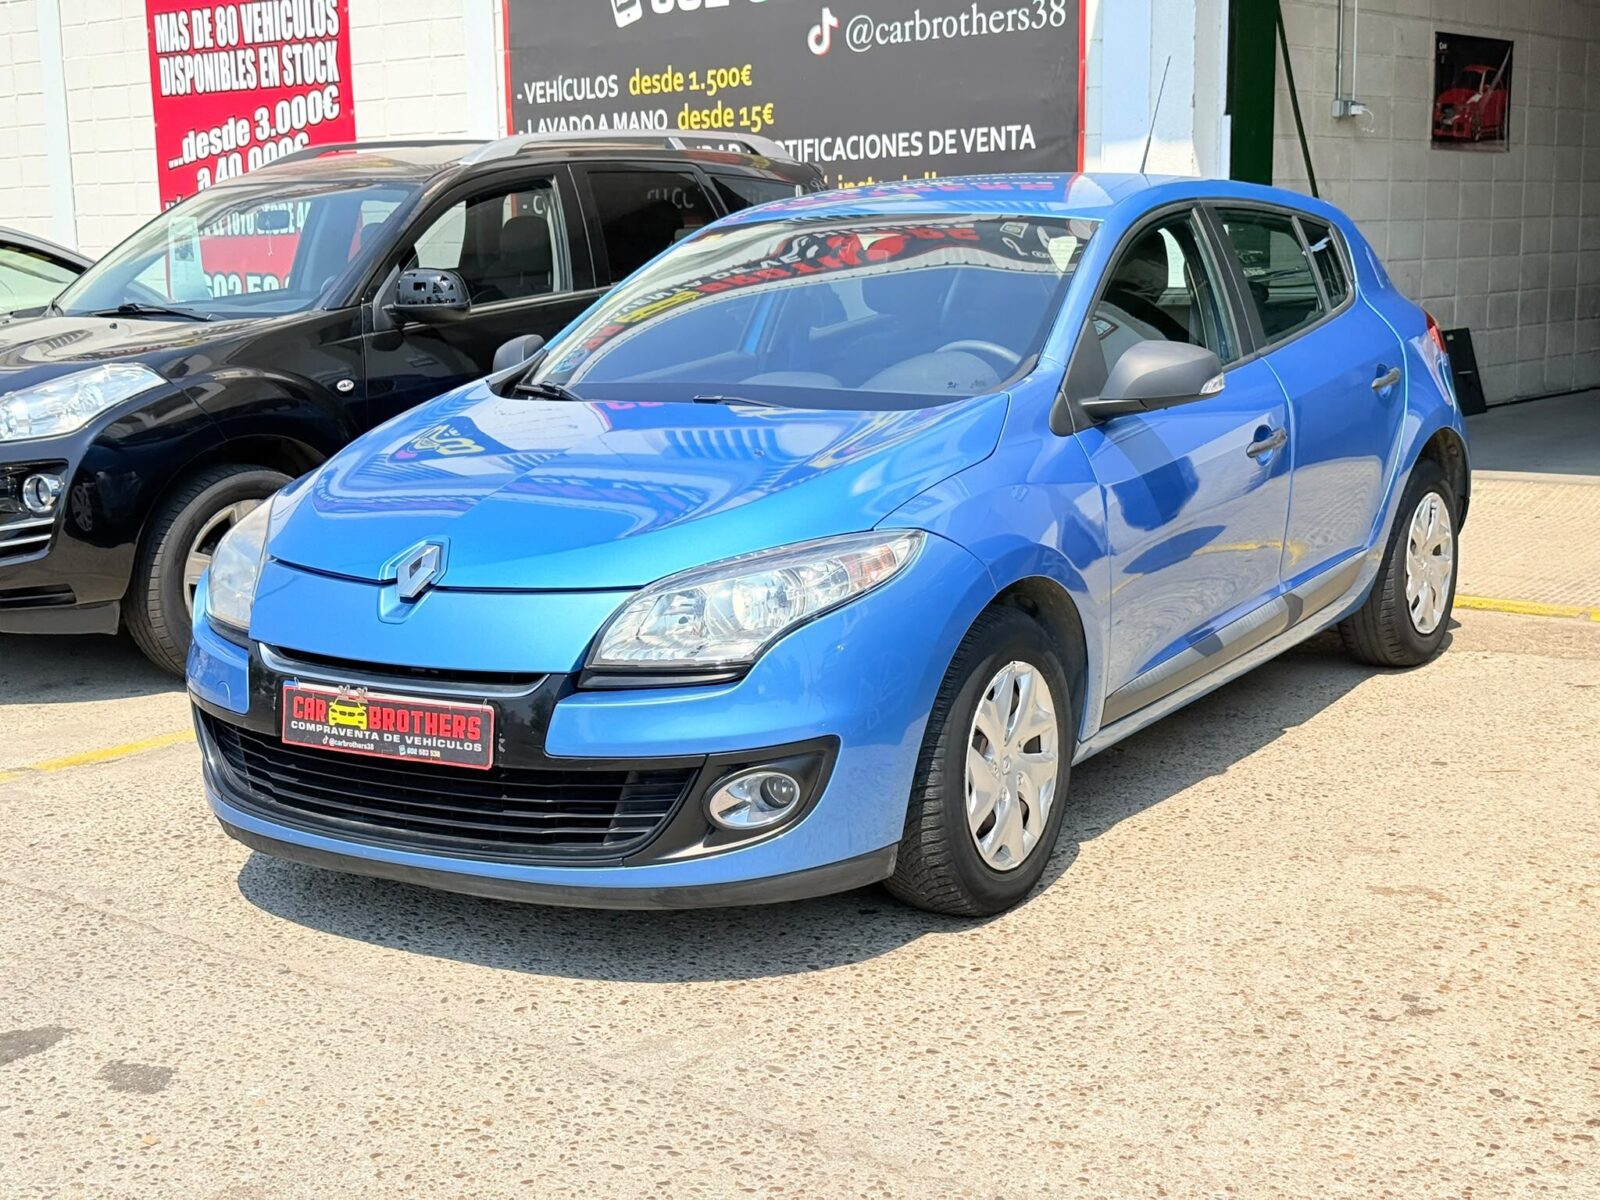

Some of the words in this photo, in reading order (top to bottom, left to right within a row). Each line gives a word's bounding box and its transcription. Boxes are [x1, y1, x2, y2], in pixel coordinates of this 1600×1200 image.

[154, 11, 189, 53] MAS
[191, 8, 214, 49] DE
[215, 5, 239, 47] 80
[846, 0, 1066, 52] @carbrothers38
[159, 48, 258, 96] DISPONIBLES
[258, 46, 280, 88] EN
[282, 40, 340, 86] STOCK
[629, 65, 684, 96] desde
[688, 64, 752, 97] 1.500€
[168, 117, 251, 169] ...desde
[254, 85, 340, 141] 3.000€
[528, 114, 594, 134] LAVADO
[595, 113, 608, 130] A
[613, 109, 668, 130] MANO
[677, 100, 734, 131] desde
[739, 103, 774, 132] 15€
[928, 130, 957, 155] DE
[960, 124, 1036, 153] VENTA
[291, 720, 379, 742] COMPRAVENTA
[384, 733, 400, 743] DE
[405, 735, 482, 752] VEHÍCULOS
[293, 696, 327, 723] CAR
[369, 706, 482, 740] BROTHERS
